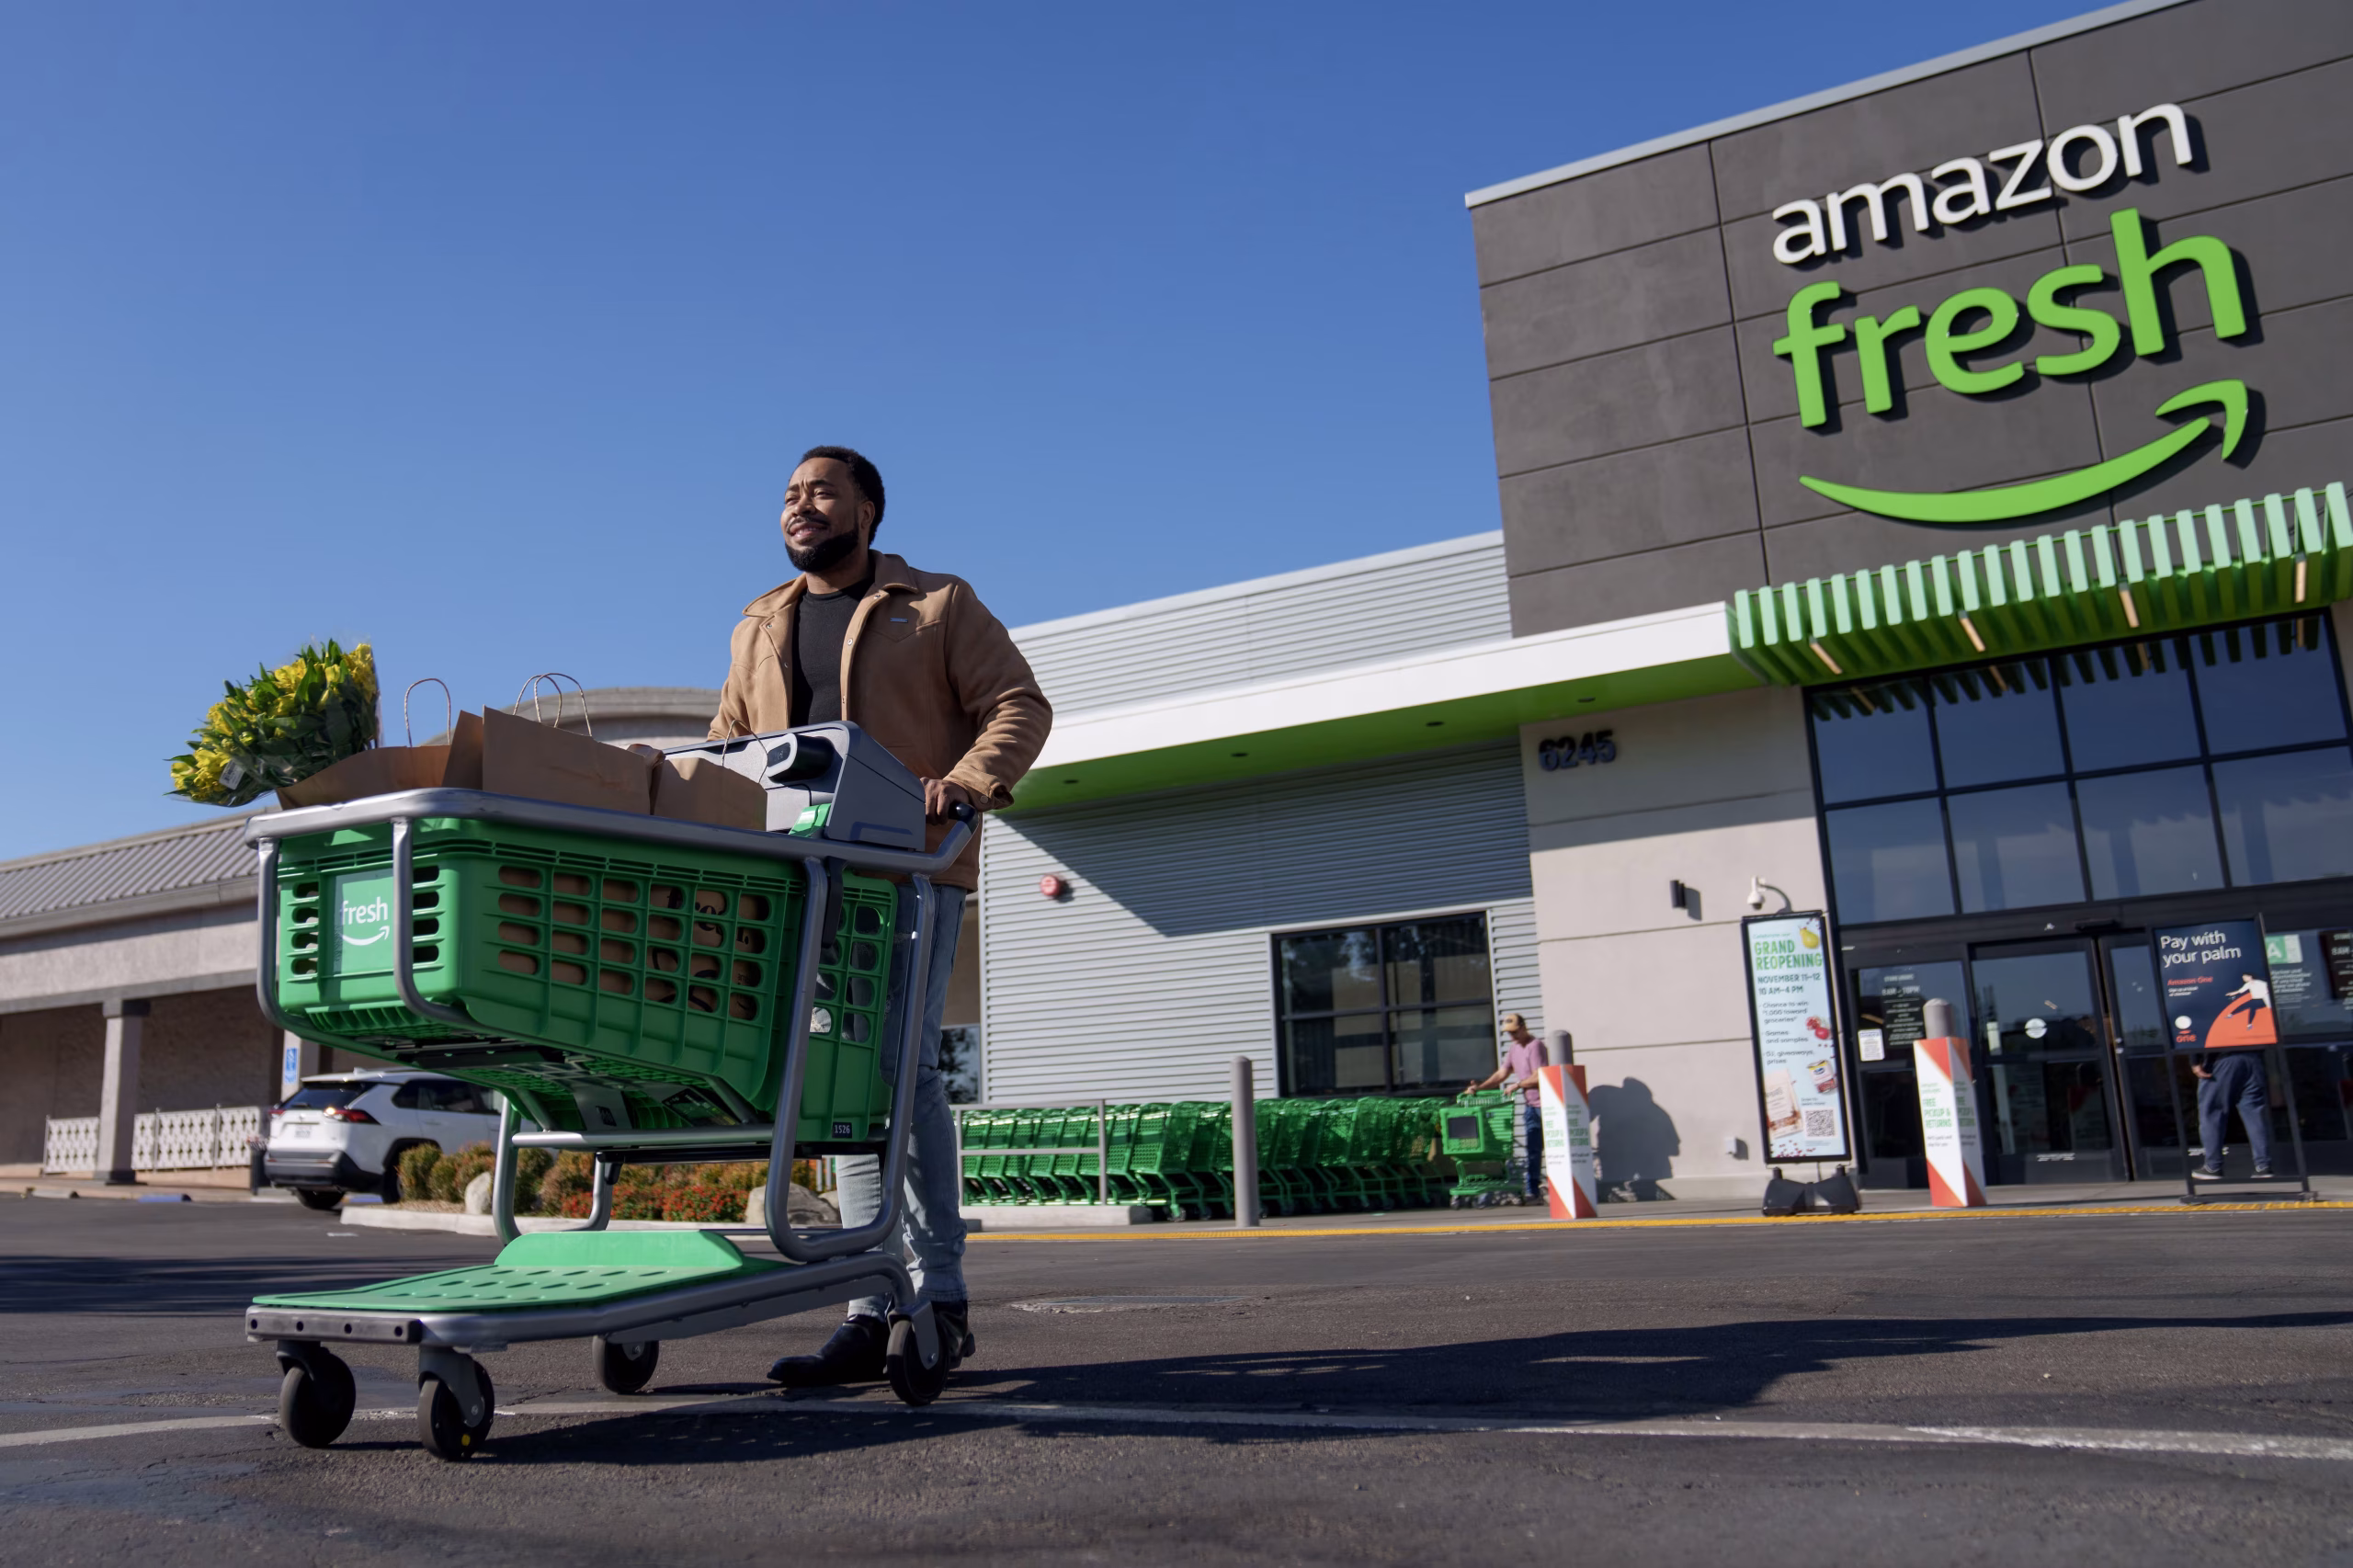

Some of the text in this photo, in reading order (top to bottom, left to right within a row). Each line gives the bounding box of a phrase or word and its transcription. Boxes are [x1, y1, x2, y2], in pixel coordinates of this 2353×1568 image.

[1773, 104, 2192, 264] amazon
[1772, 208, 2246, 428] fresh
[1539, 730, 1616, 771] 6245
[339, 896, 388, 926] fresh
[1755, 939, 1796, 956] GRAND
[2160, 930, 2226, 950] Pay with
[2162, 946, 2242, 968] your palm
[2268, 942, 2282, 959] A
[1756, 953, 1823, 971] REOPENING
[1757, 974, 1800, 984] NOVEMBER
[2167, 976, 2213, 986] Amazon One
[2176, 1034, 2196, 1043] one
[835, 1124, 851, 1134] 1526
